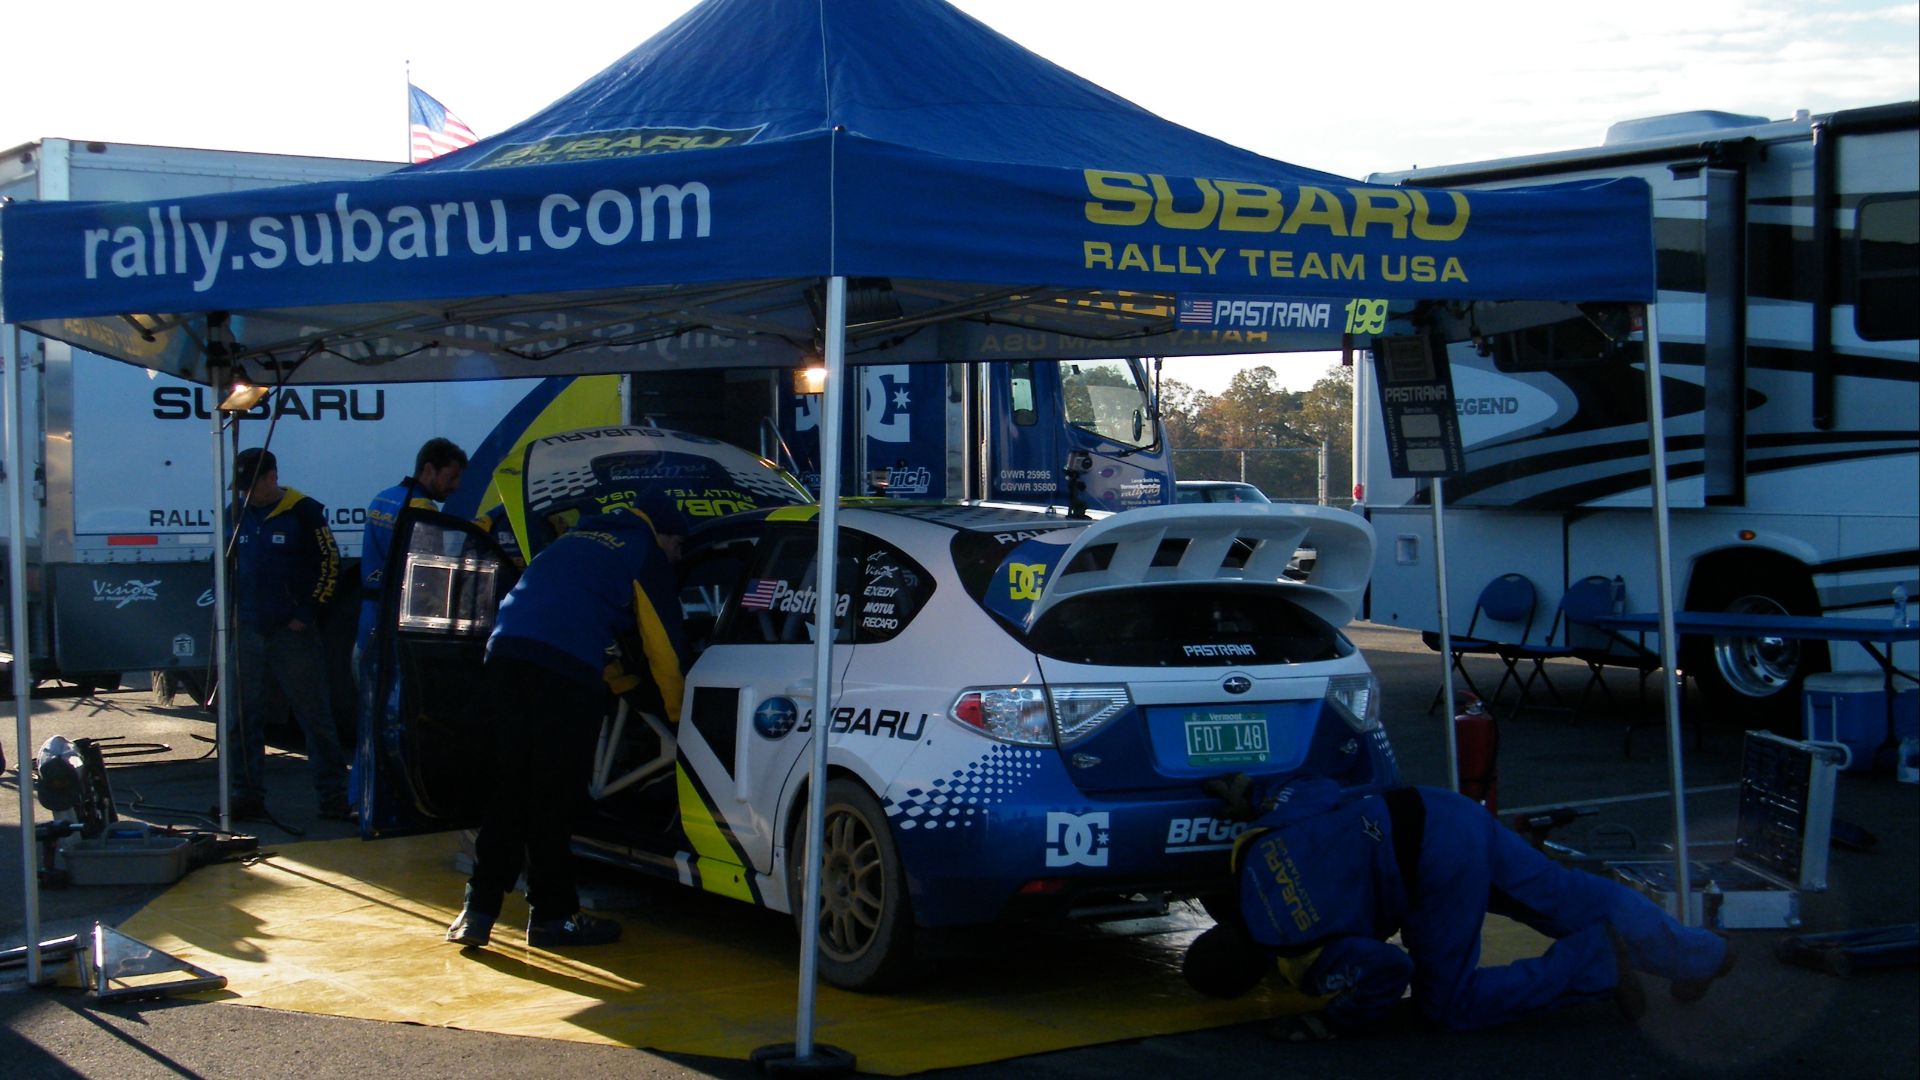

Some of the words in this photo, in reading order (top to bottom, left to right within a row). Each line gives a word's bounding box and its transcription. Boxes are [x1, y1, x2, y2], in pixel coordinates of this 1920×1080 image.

[500, 135, 732, 161] SUBARU
[1084, 169, 1470, 242] SUBARU
[84, 181, 711, 292] rally.subaru.com
[1084, 241, 1226, 275] RALLY
[1240, 249, 1366, 281] TEAM
[1382, 254, 1469, 284] USA
[1214, 300, 1331, 328] PASTRANA
[1344, 299, 1389, 335] 199
[1385, 384, 1447, 402] PASTRANA
[1456, 397, 1519, 416] EGEND
[541, 427, 665, 446] SUBARU
[1000, 470, 1025, 479] GVWR
[1027, 469, 1051, 479] 25995
[664, 488, 696, 497] TE
[1000, 482, 1031, 492] CGVWR
[594, 490, 637, 504] USA
[149, 509, 216, 527] RALL
[769, 580, 851, 617] Pastra
[863, 585, 898, 597] EXEDY
[863, 602, 895, 615] MOTUL
[862, 617, 898, 630] RECARO
[1183, 644, 1257, 657] PASTRANA
[797, 707, 928, 741] SBARU
[1209, 713, 1242, 721] Vermont
[1193, 726, 1222, 752] FDT
[1234, 725, 1263, 751] 148
[1046, 812, 1109, 867] DC
[1259, 839, 1313, 933] SUBARU
